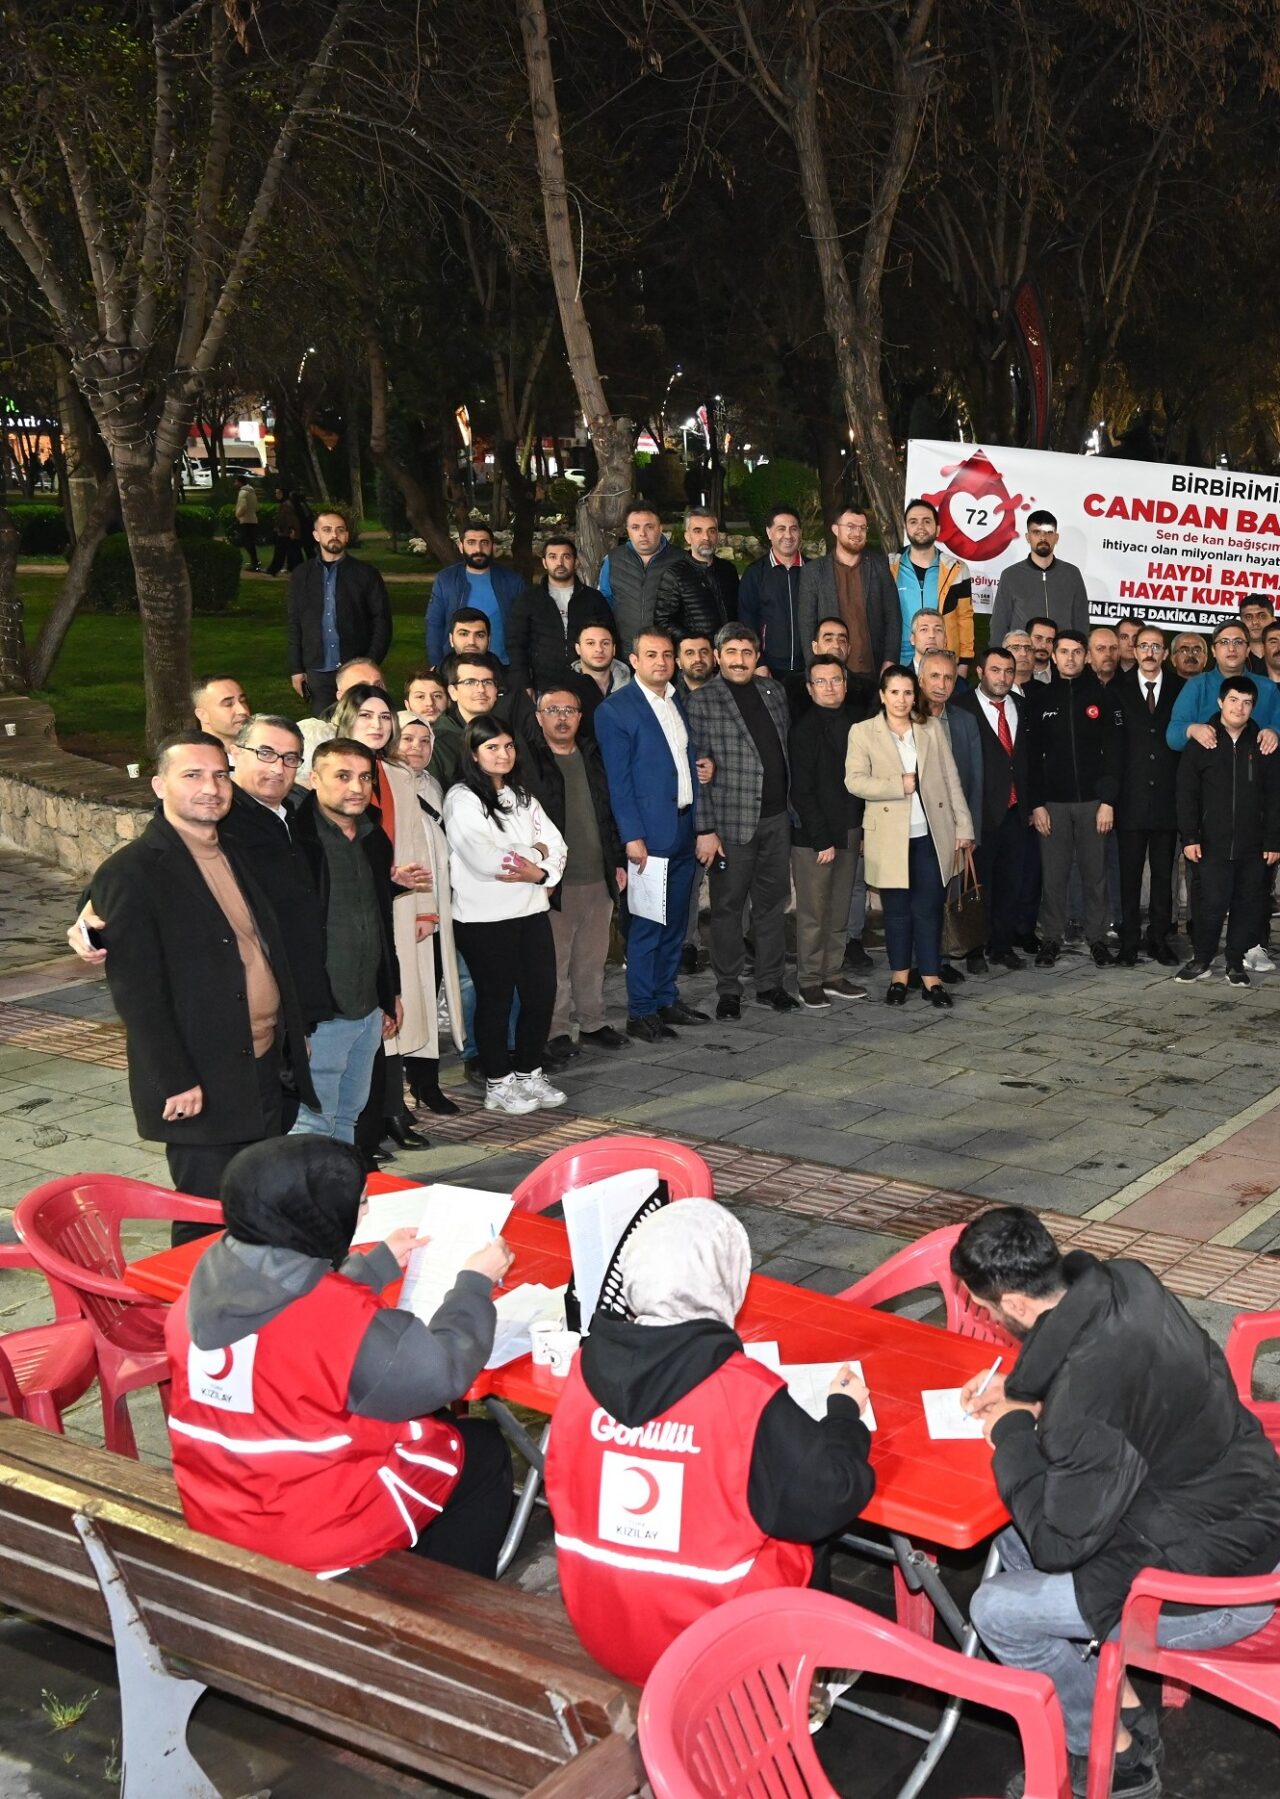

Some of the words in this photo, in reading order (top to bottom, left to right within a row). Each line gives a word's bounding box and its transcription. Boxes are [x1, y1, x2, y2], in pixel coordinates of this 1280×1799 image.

[965, 508, 988, 526] 72
[1083, 493, 1228, 530] CANDAN
[1156, 529, 1180, 542] Sen
[1182, 531, 1199, 543] de
[1202, 533, 1224, 546] kan
[1102, 539, 1148, 554] ihtiyacı
[1151, 543, 1178, 556] olan
[1181, 546, 1243, 563] milyonları
[1147, 562, 1213, 584] HAYDİ
[1119, 580, 1189, 602] HAYAT
[1104, 602, 1131, 618] İÇİN
[1132, 607, 1146, 618] 15
[1147, 608, 1197, 624] DAKİKA
[616, 1525, 658, 1540] KIZILAY
